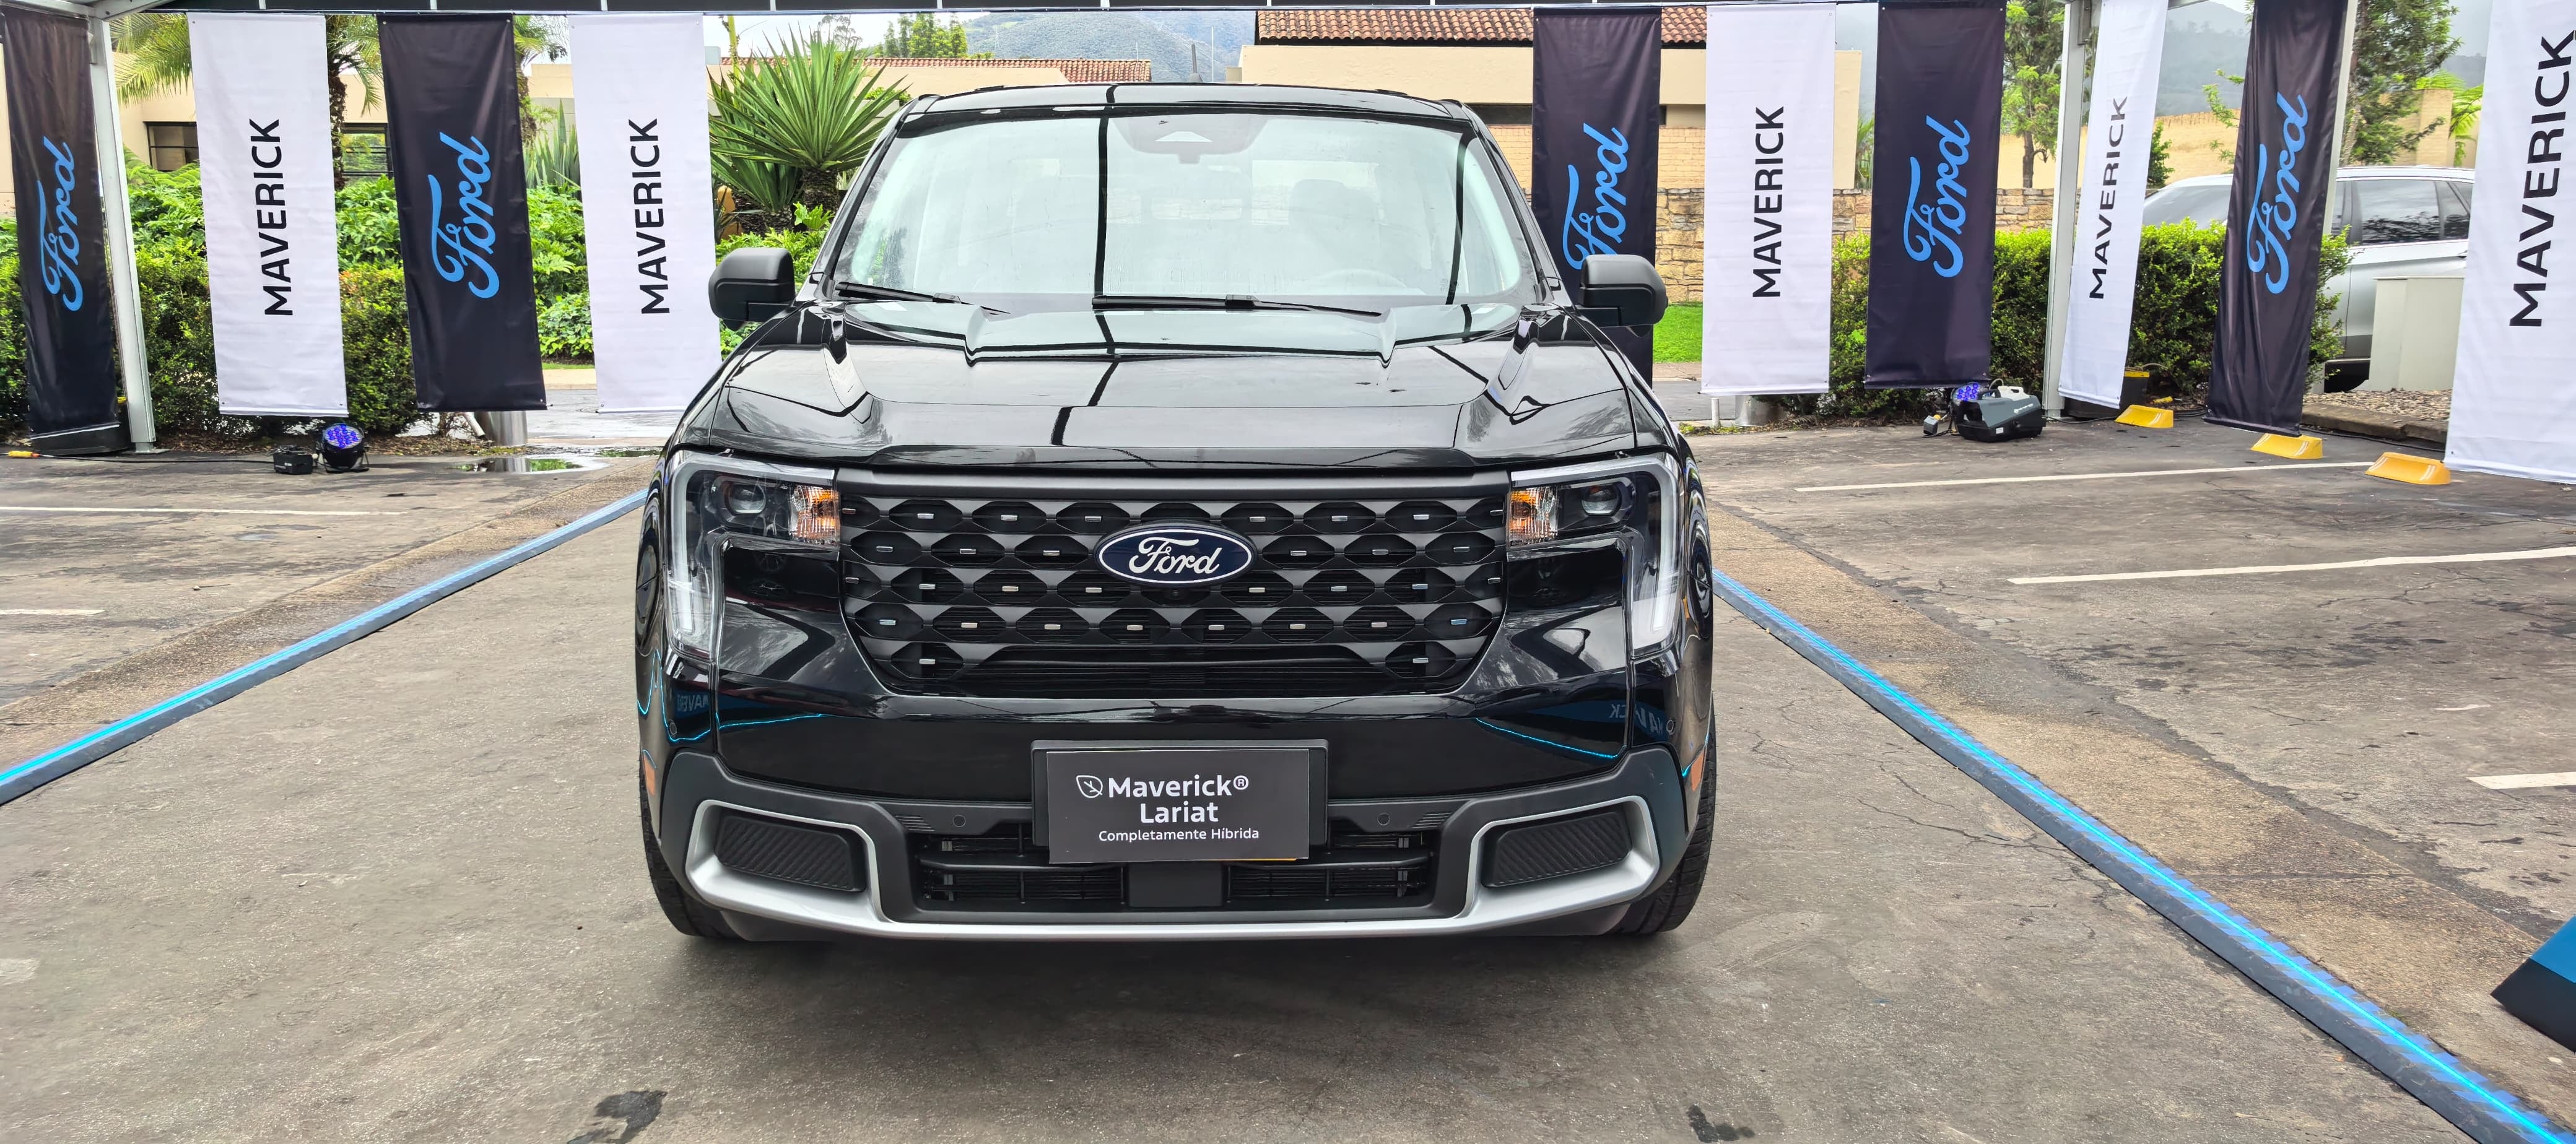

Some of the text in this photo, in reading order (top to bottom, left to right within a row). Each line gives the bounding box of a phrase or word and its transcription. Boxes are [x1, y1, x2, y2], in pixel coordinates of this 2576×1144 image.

[38, 138, 82, 311] Ford
[250, 119, 293, 315] MAVERICK
[428, 132, 499, 298] Ford
[629, 119, 669, 314] MAVERICK
[1753, 106, 1783, 297] MAVERICK
[1904, 115, 1970, 277] Ford
[2089, 96, 2128, 299] MAVERICK
[2247, 93, 2308, 294] Ford
[2510, 30, 2575, 327] MAVERICK
[1129, 537, 1222, 573] Ford
[1099, 828, 1258, 843] Completamente Híbrida
[1141, 801, 1218, 823] Lariat
